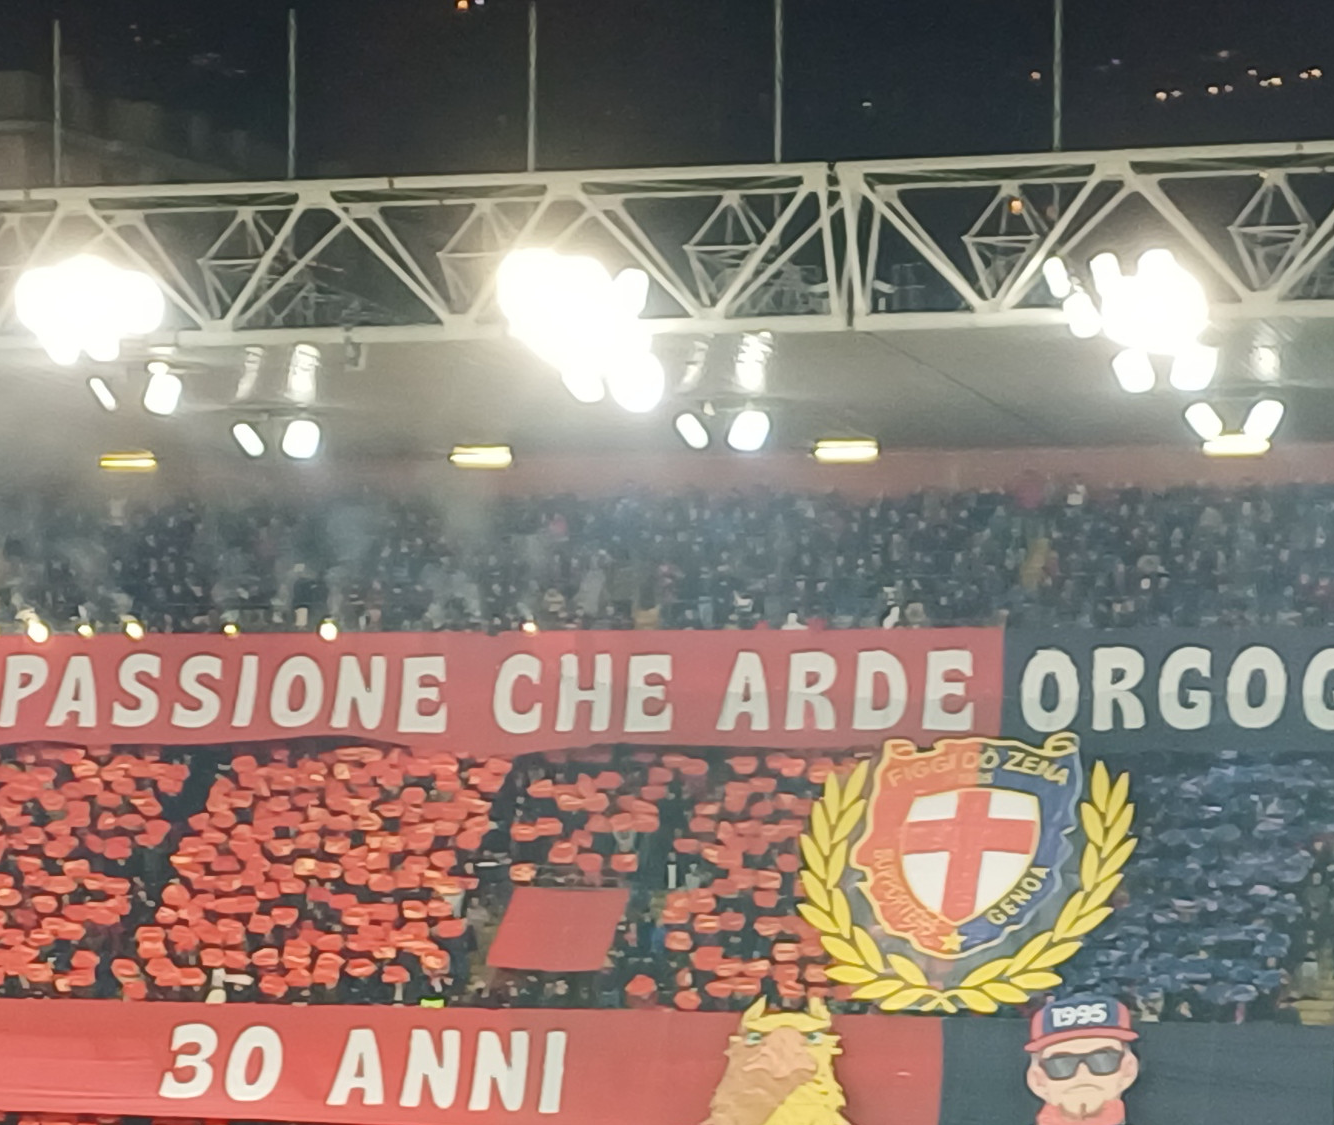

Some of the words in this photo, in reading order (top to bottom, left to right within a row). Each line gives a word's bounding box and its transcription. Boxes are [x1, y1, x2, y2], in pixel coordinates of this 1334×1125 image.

[492, 652, 673, 734] CHE
[715, 649, 975, 732] ARDE
[886, 752, 957, 787] FIGGI
[982, 866, 1051, 925] GENOA
[1050, 1003, 1108, 1028] 1995
[159, 1023, 283, 1102] 30
[326, 1028, 567, 1114] ANNI
